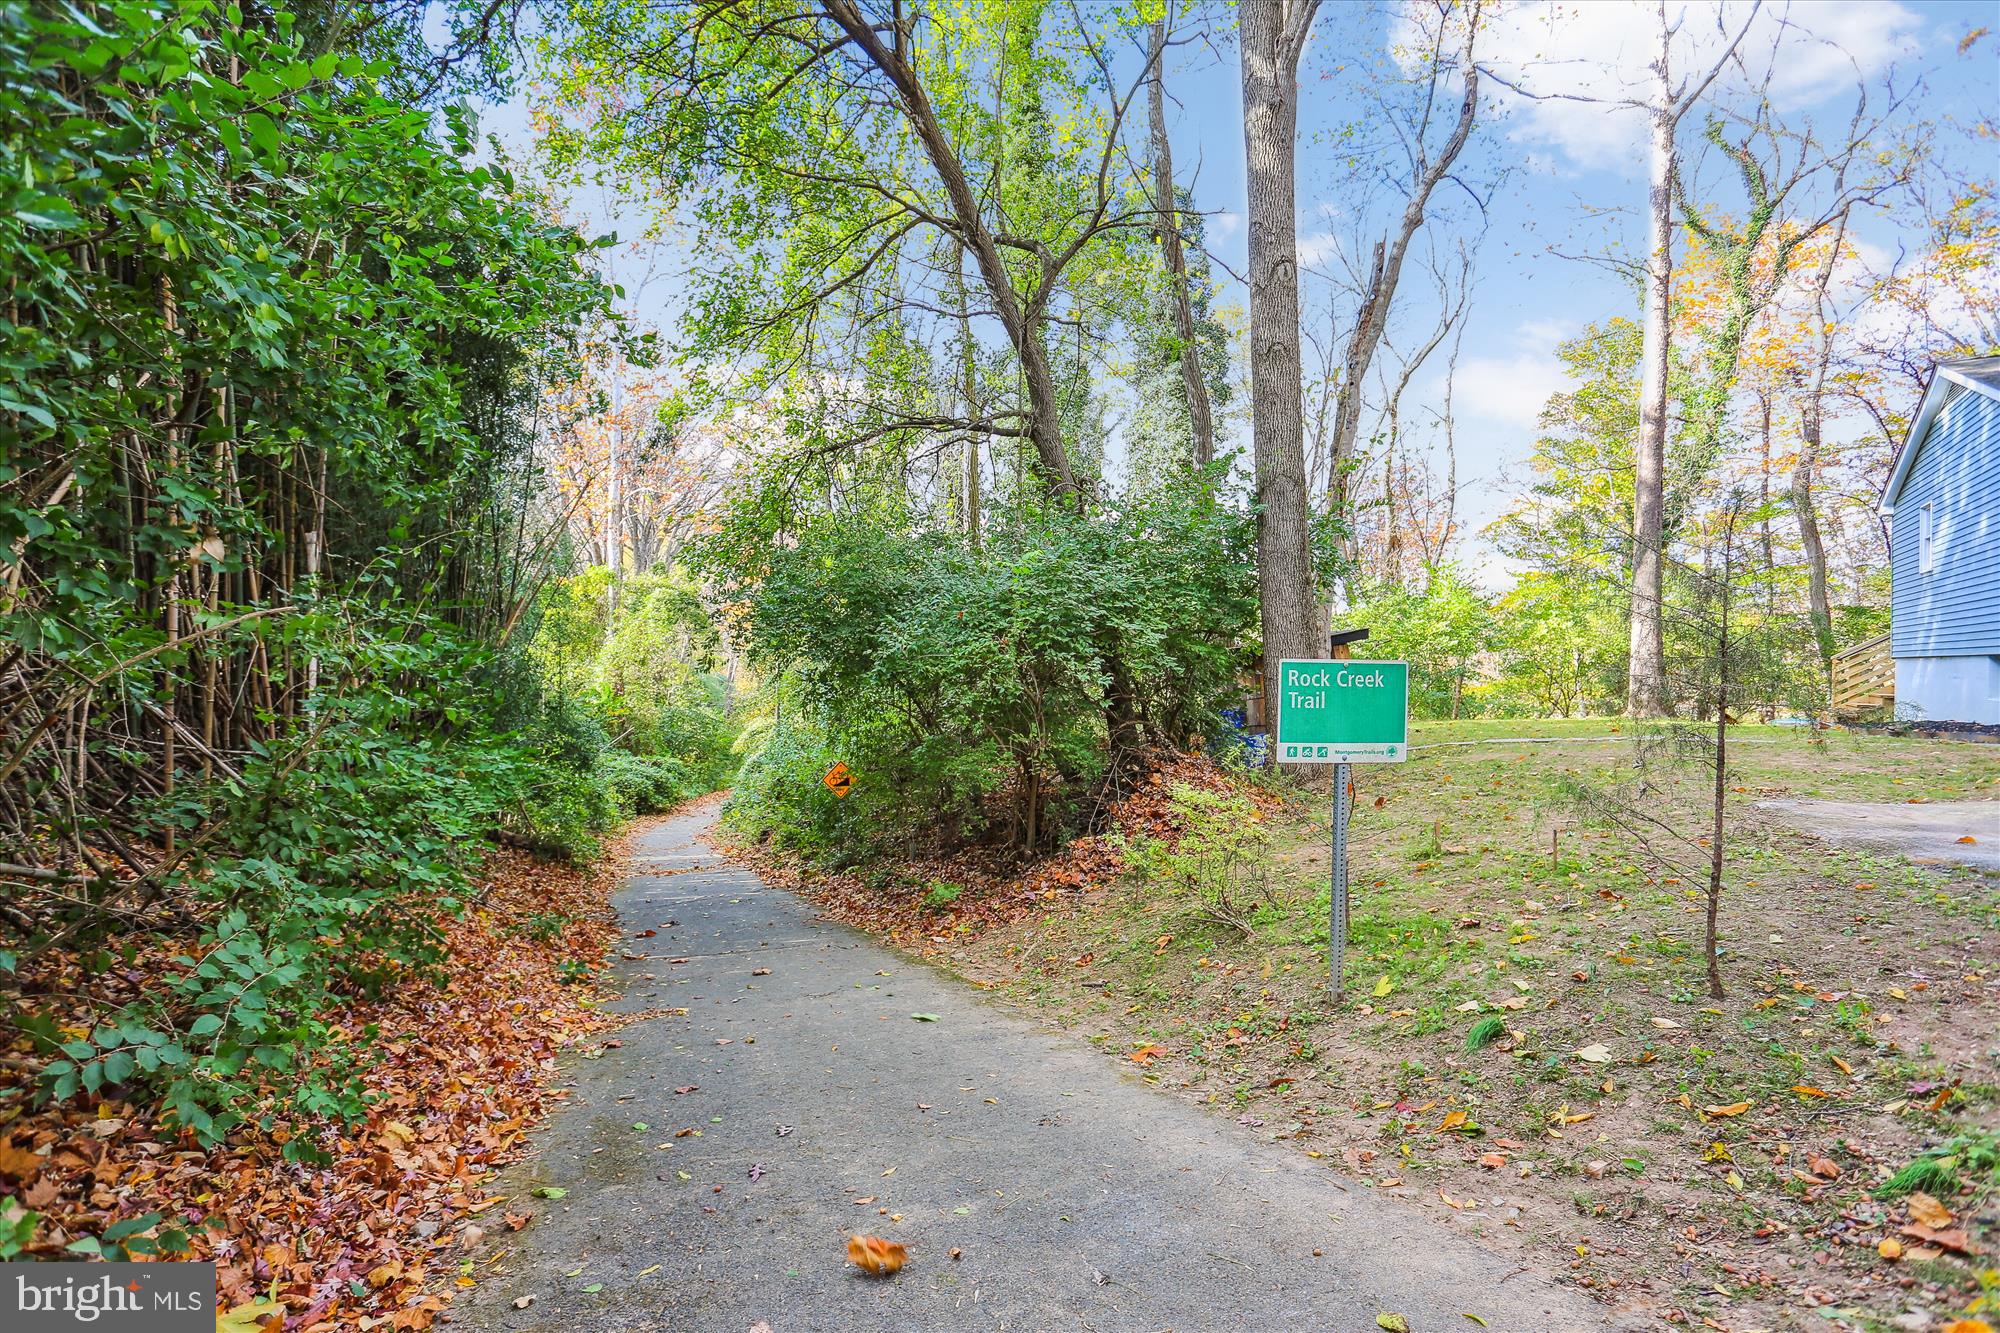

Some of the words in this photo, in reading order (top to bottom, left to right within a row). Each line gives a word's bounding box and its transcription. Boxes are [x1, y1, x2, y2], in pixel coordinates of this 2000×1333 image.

[1288, 669, 1330, 687] Rock
[1336, 670, 1385, 688] Creek
[1288, 691, 1326, 709] Trail
